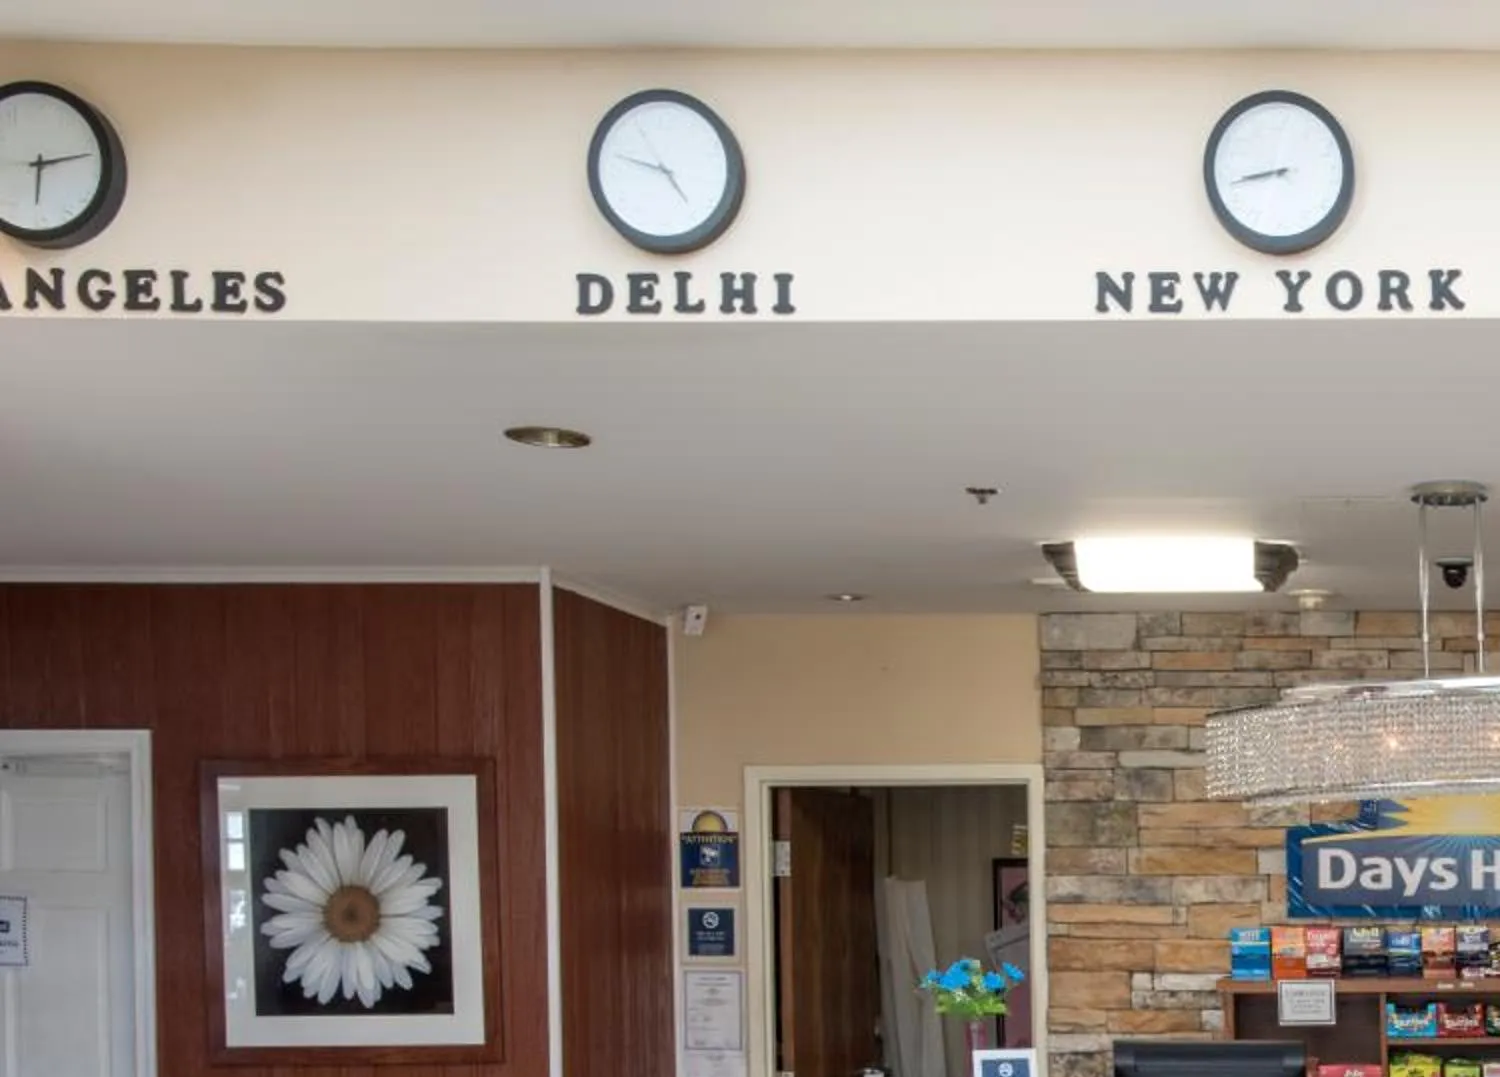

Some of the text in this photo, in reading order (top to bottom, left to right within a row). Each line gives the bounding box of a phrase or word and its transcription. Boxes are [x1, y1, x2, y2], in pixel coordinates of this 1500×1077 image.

[576, 271, 796, 315] DELHI
[1095, 270, 1465, 312] NEW YORK
[1318, 848, 1459, 897] Days
